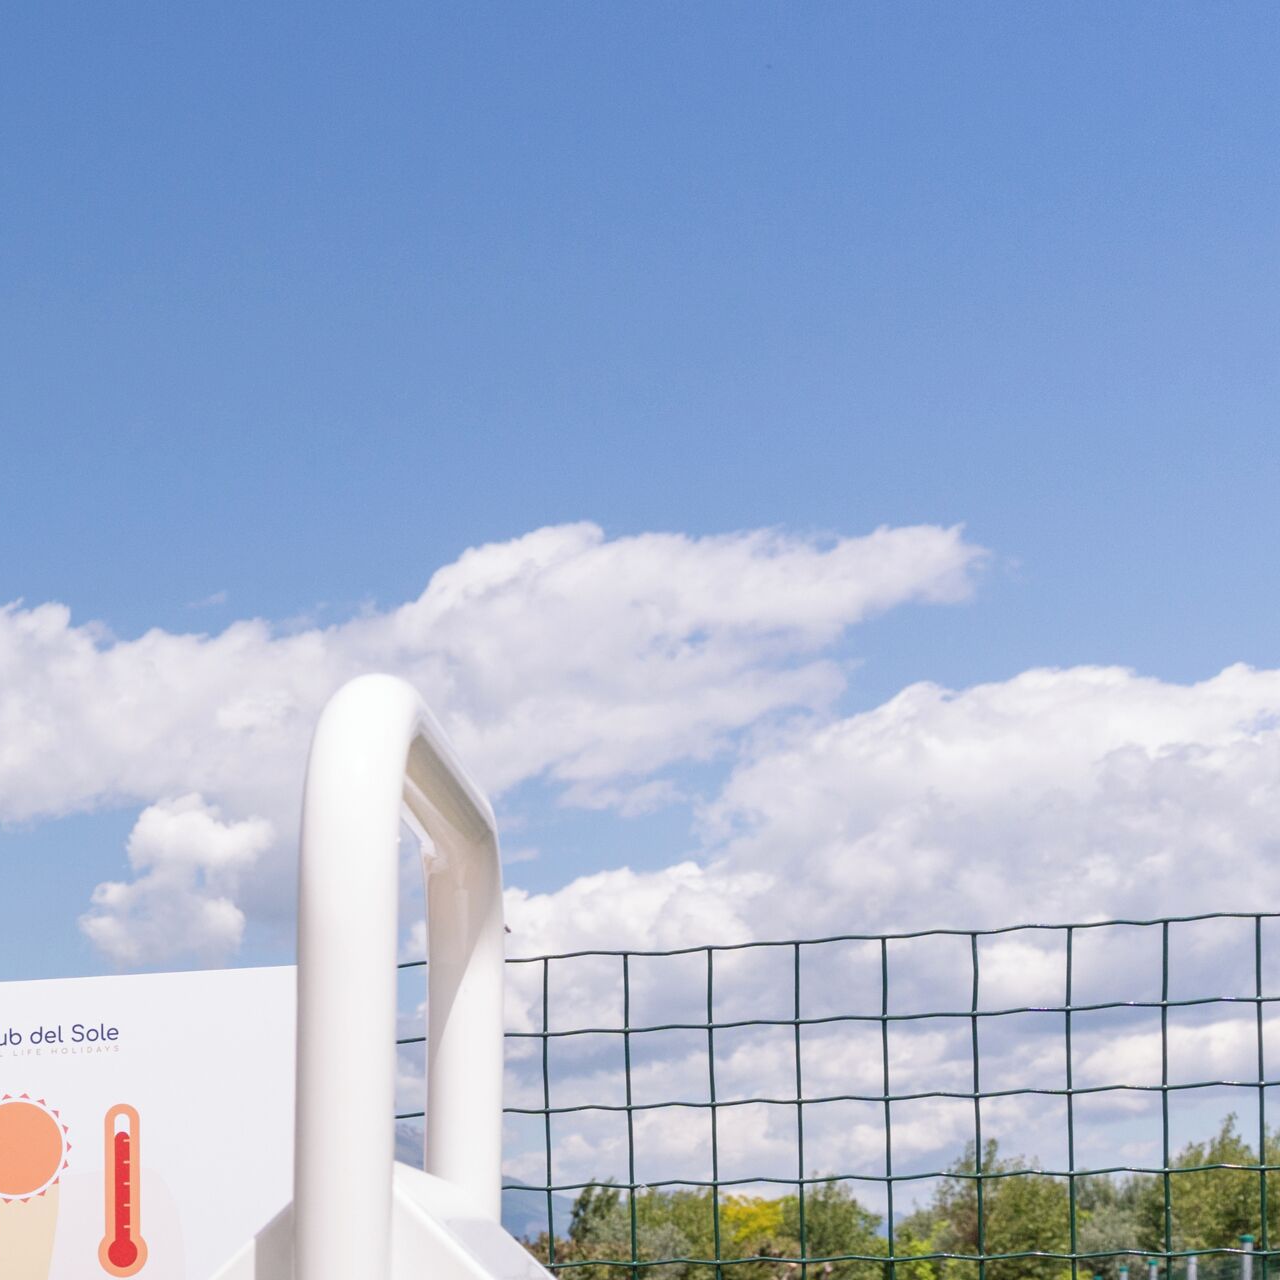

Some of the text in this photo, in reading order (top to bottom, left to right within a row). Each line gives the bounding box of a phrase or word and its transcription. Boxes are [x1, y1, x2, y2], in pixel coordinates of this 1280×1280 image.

[30, 1025, 64, 1044] del
[71, 1023, 119, 1042] Sole
[13, 1048, 42, 1057] LIFE
[51, 1045, 120, 1055] HOLIDAYS
